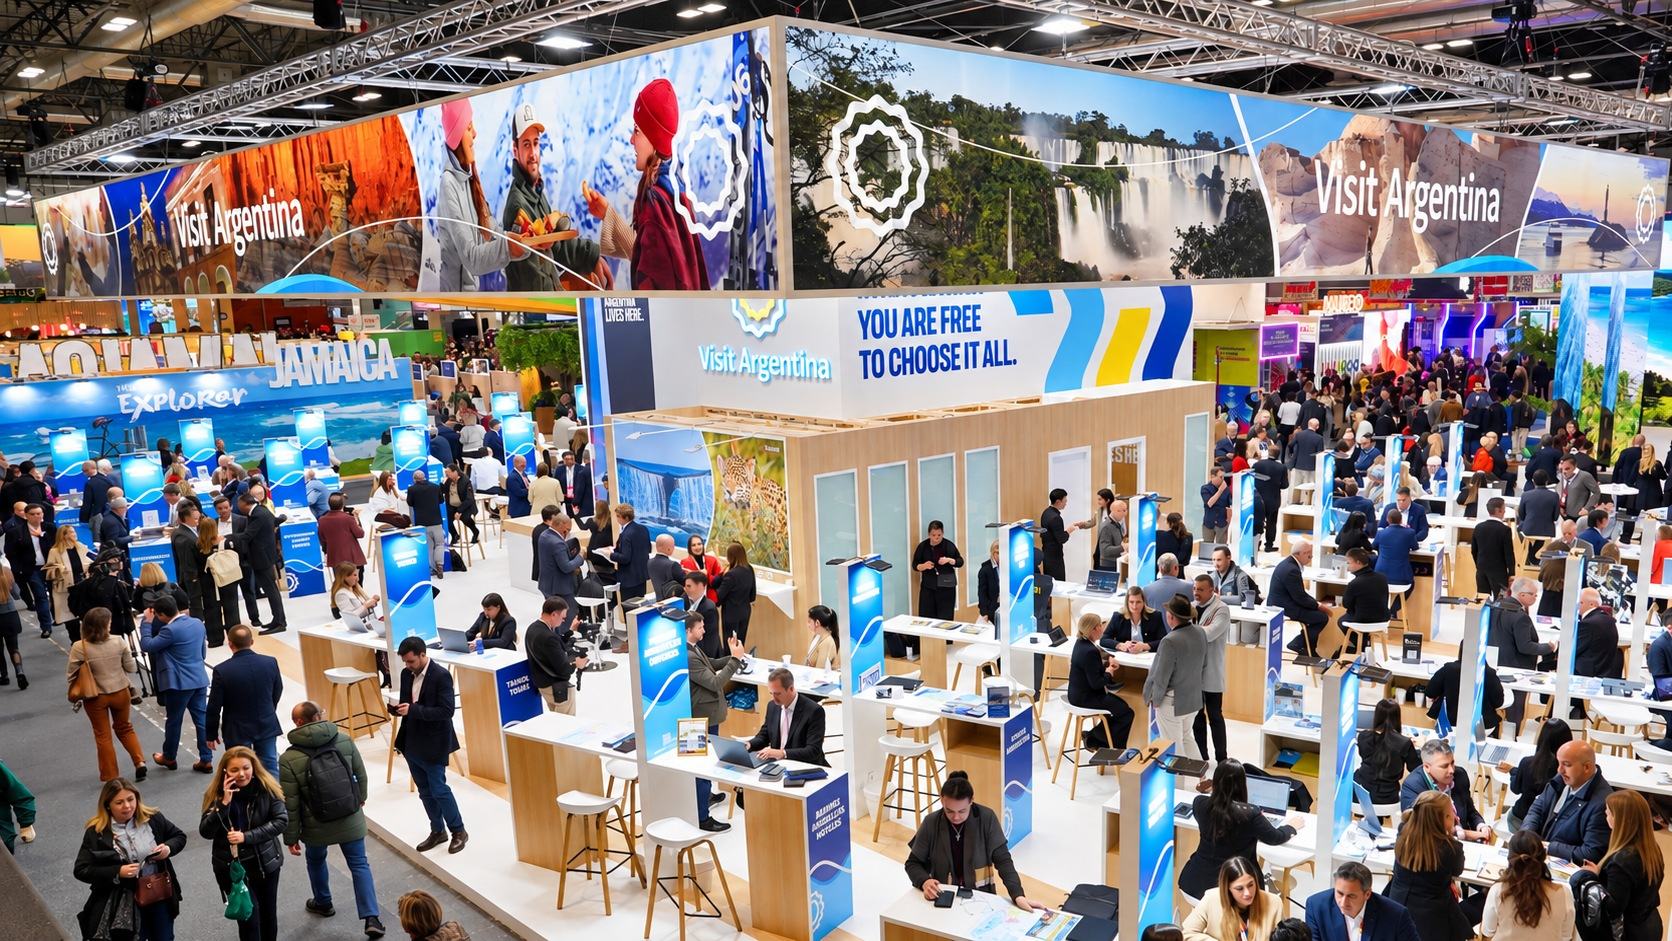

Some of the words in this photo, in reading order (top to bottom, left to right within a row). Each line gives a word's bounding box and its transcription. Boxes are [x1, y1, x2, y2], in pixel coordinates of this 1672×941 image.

[1314, 156, 1379, 217] Visit
[1383, 167, 1501, 234] Argentina
[173, 201, 212, 248] Visit
[213, 187, 305, 257] Argentina
[605, 308, 624, 322] LIVES
[625, 308, 645, 322] HERE.
[857, 308, 898, 340] YOU
[901, 306, 937, 337] ARE
[941, 304, 982, 334] FREE
[269, 338, 399, 389] JAMAICA
[698, 344, 737, 373] Visit
[738, 346, 832, 383] Argentina
[859, 348, 885, 379] TO
[888, 343, 961, 377] CHOOSE
[964, 341, 980, 370] IT
[982, 339, 1018, 368] ALL.
